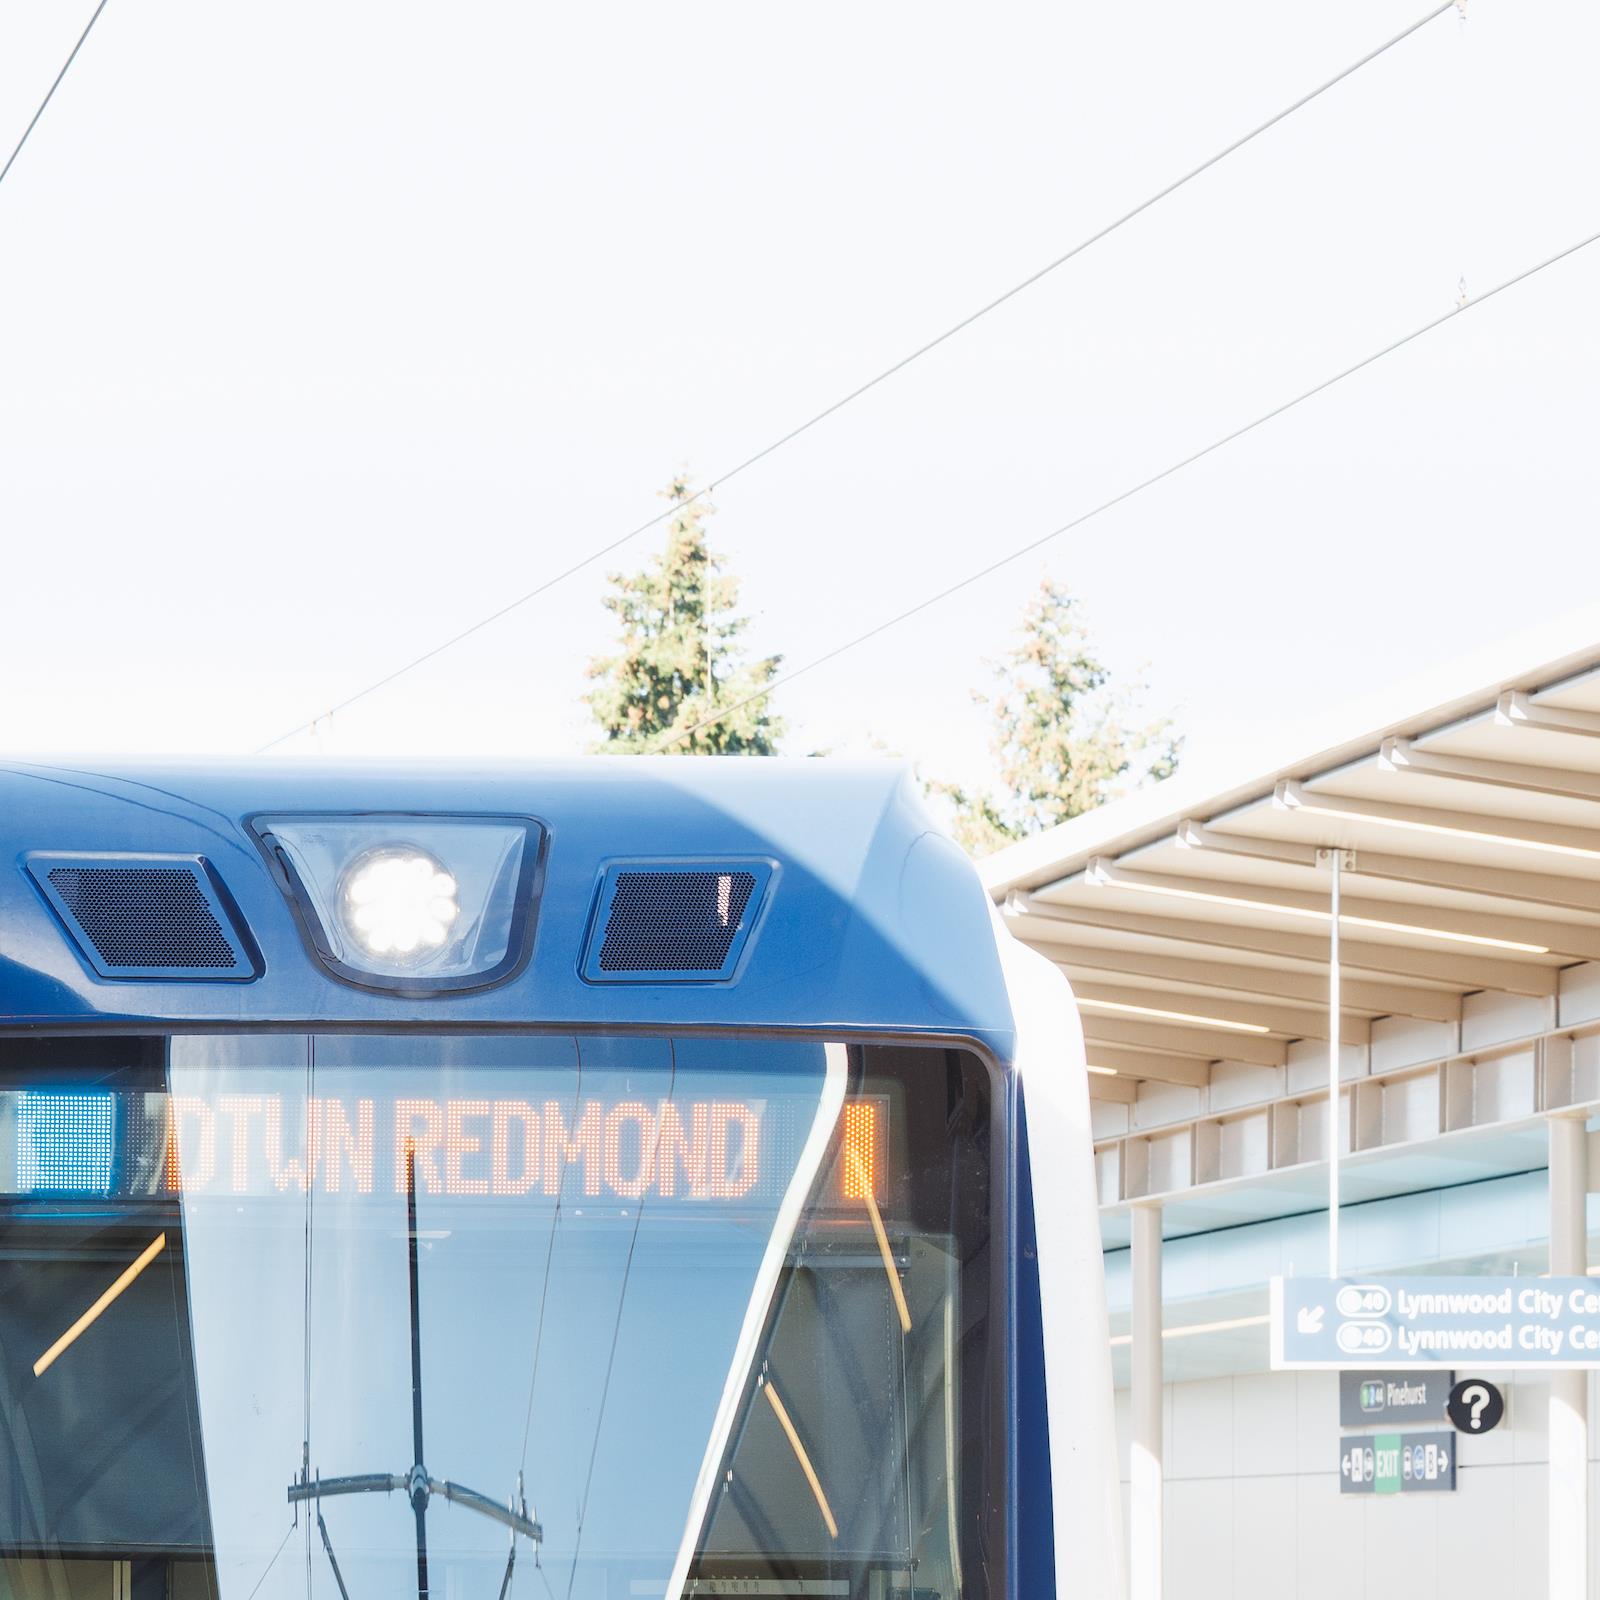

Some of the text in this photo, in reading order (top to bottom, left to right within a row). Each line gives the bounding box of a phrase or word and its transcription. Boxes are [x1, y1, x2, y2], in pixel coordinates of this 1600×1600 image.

[164, 1096, 761, 1199] DTWN REDMOND
[1397, 1288, 1512, 1319] Lynnwood
[1518, 1288, 1564, 1319] City
[1397, 1324, 1513, 1356] Lynnwood
[1518, 1324, 1564, 1356] City
[1387, 1382, 1427, 1407] Pinehurst
[1376, 1450, 1399, 1479] EXIT
